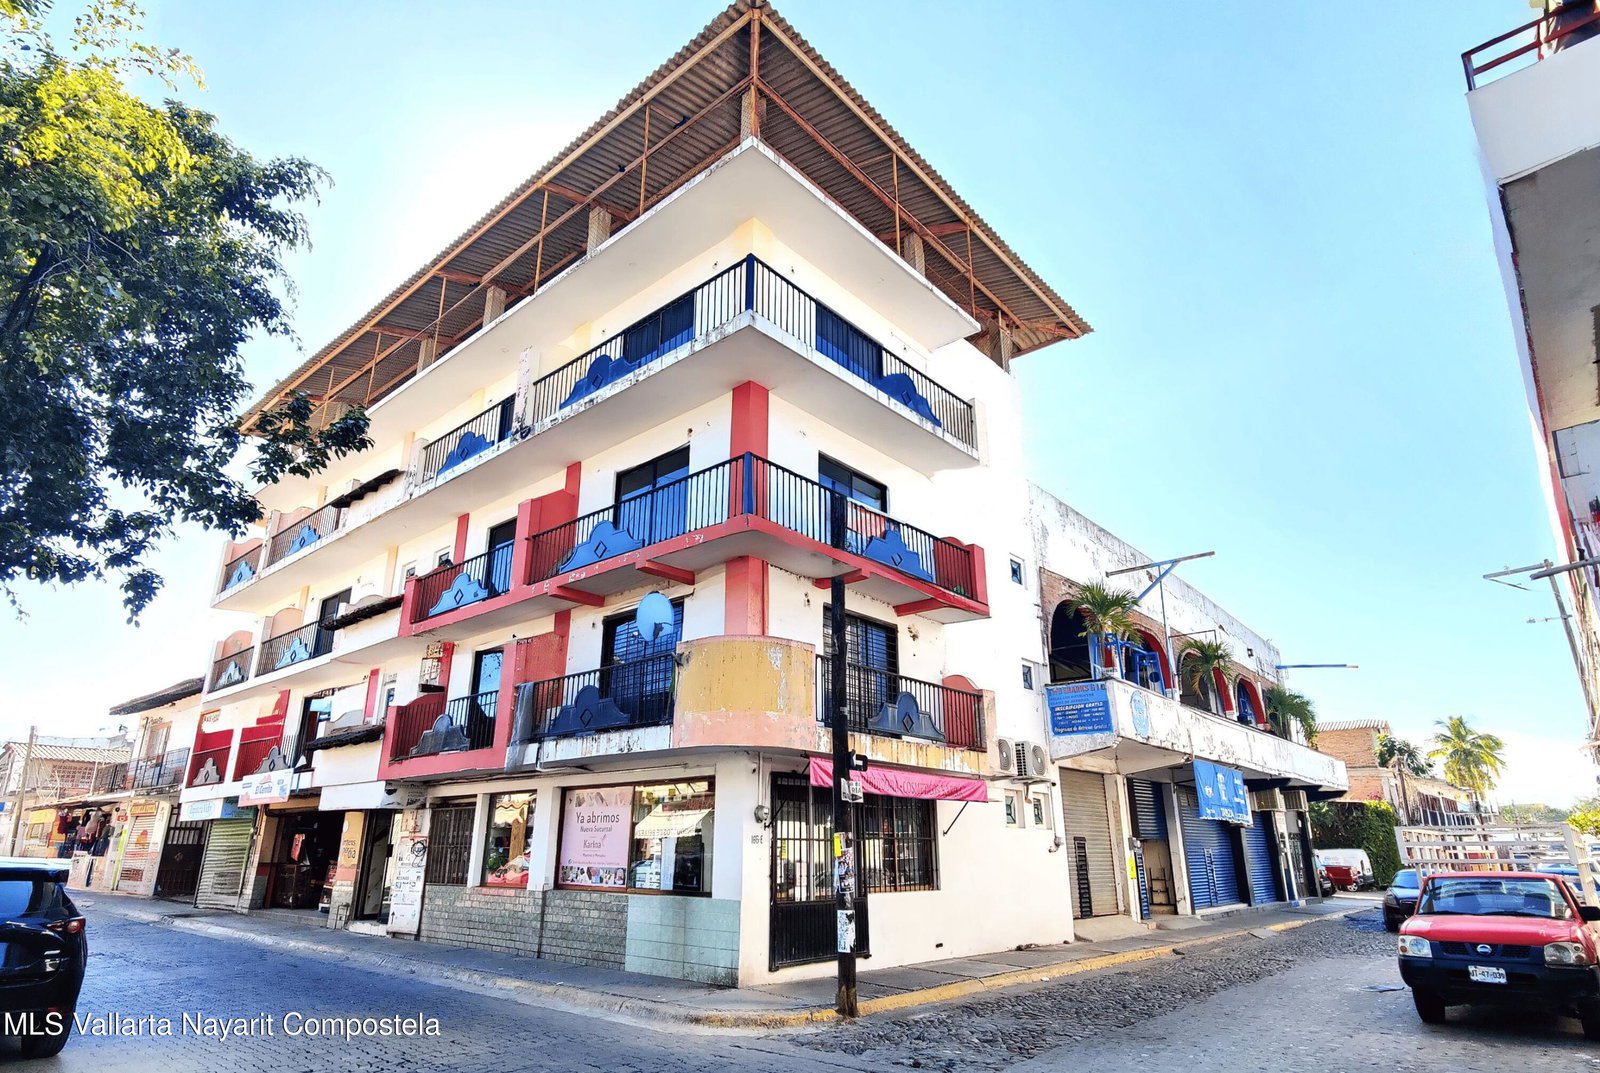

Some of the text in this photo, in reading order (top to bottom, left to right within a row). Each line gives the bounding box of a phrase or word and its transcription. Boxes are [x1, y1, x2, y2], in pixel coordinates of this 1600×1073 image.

[576, 811, 620, 824] Ya abrimos
[583, 839, 602, 849] Karina
